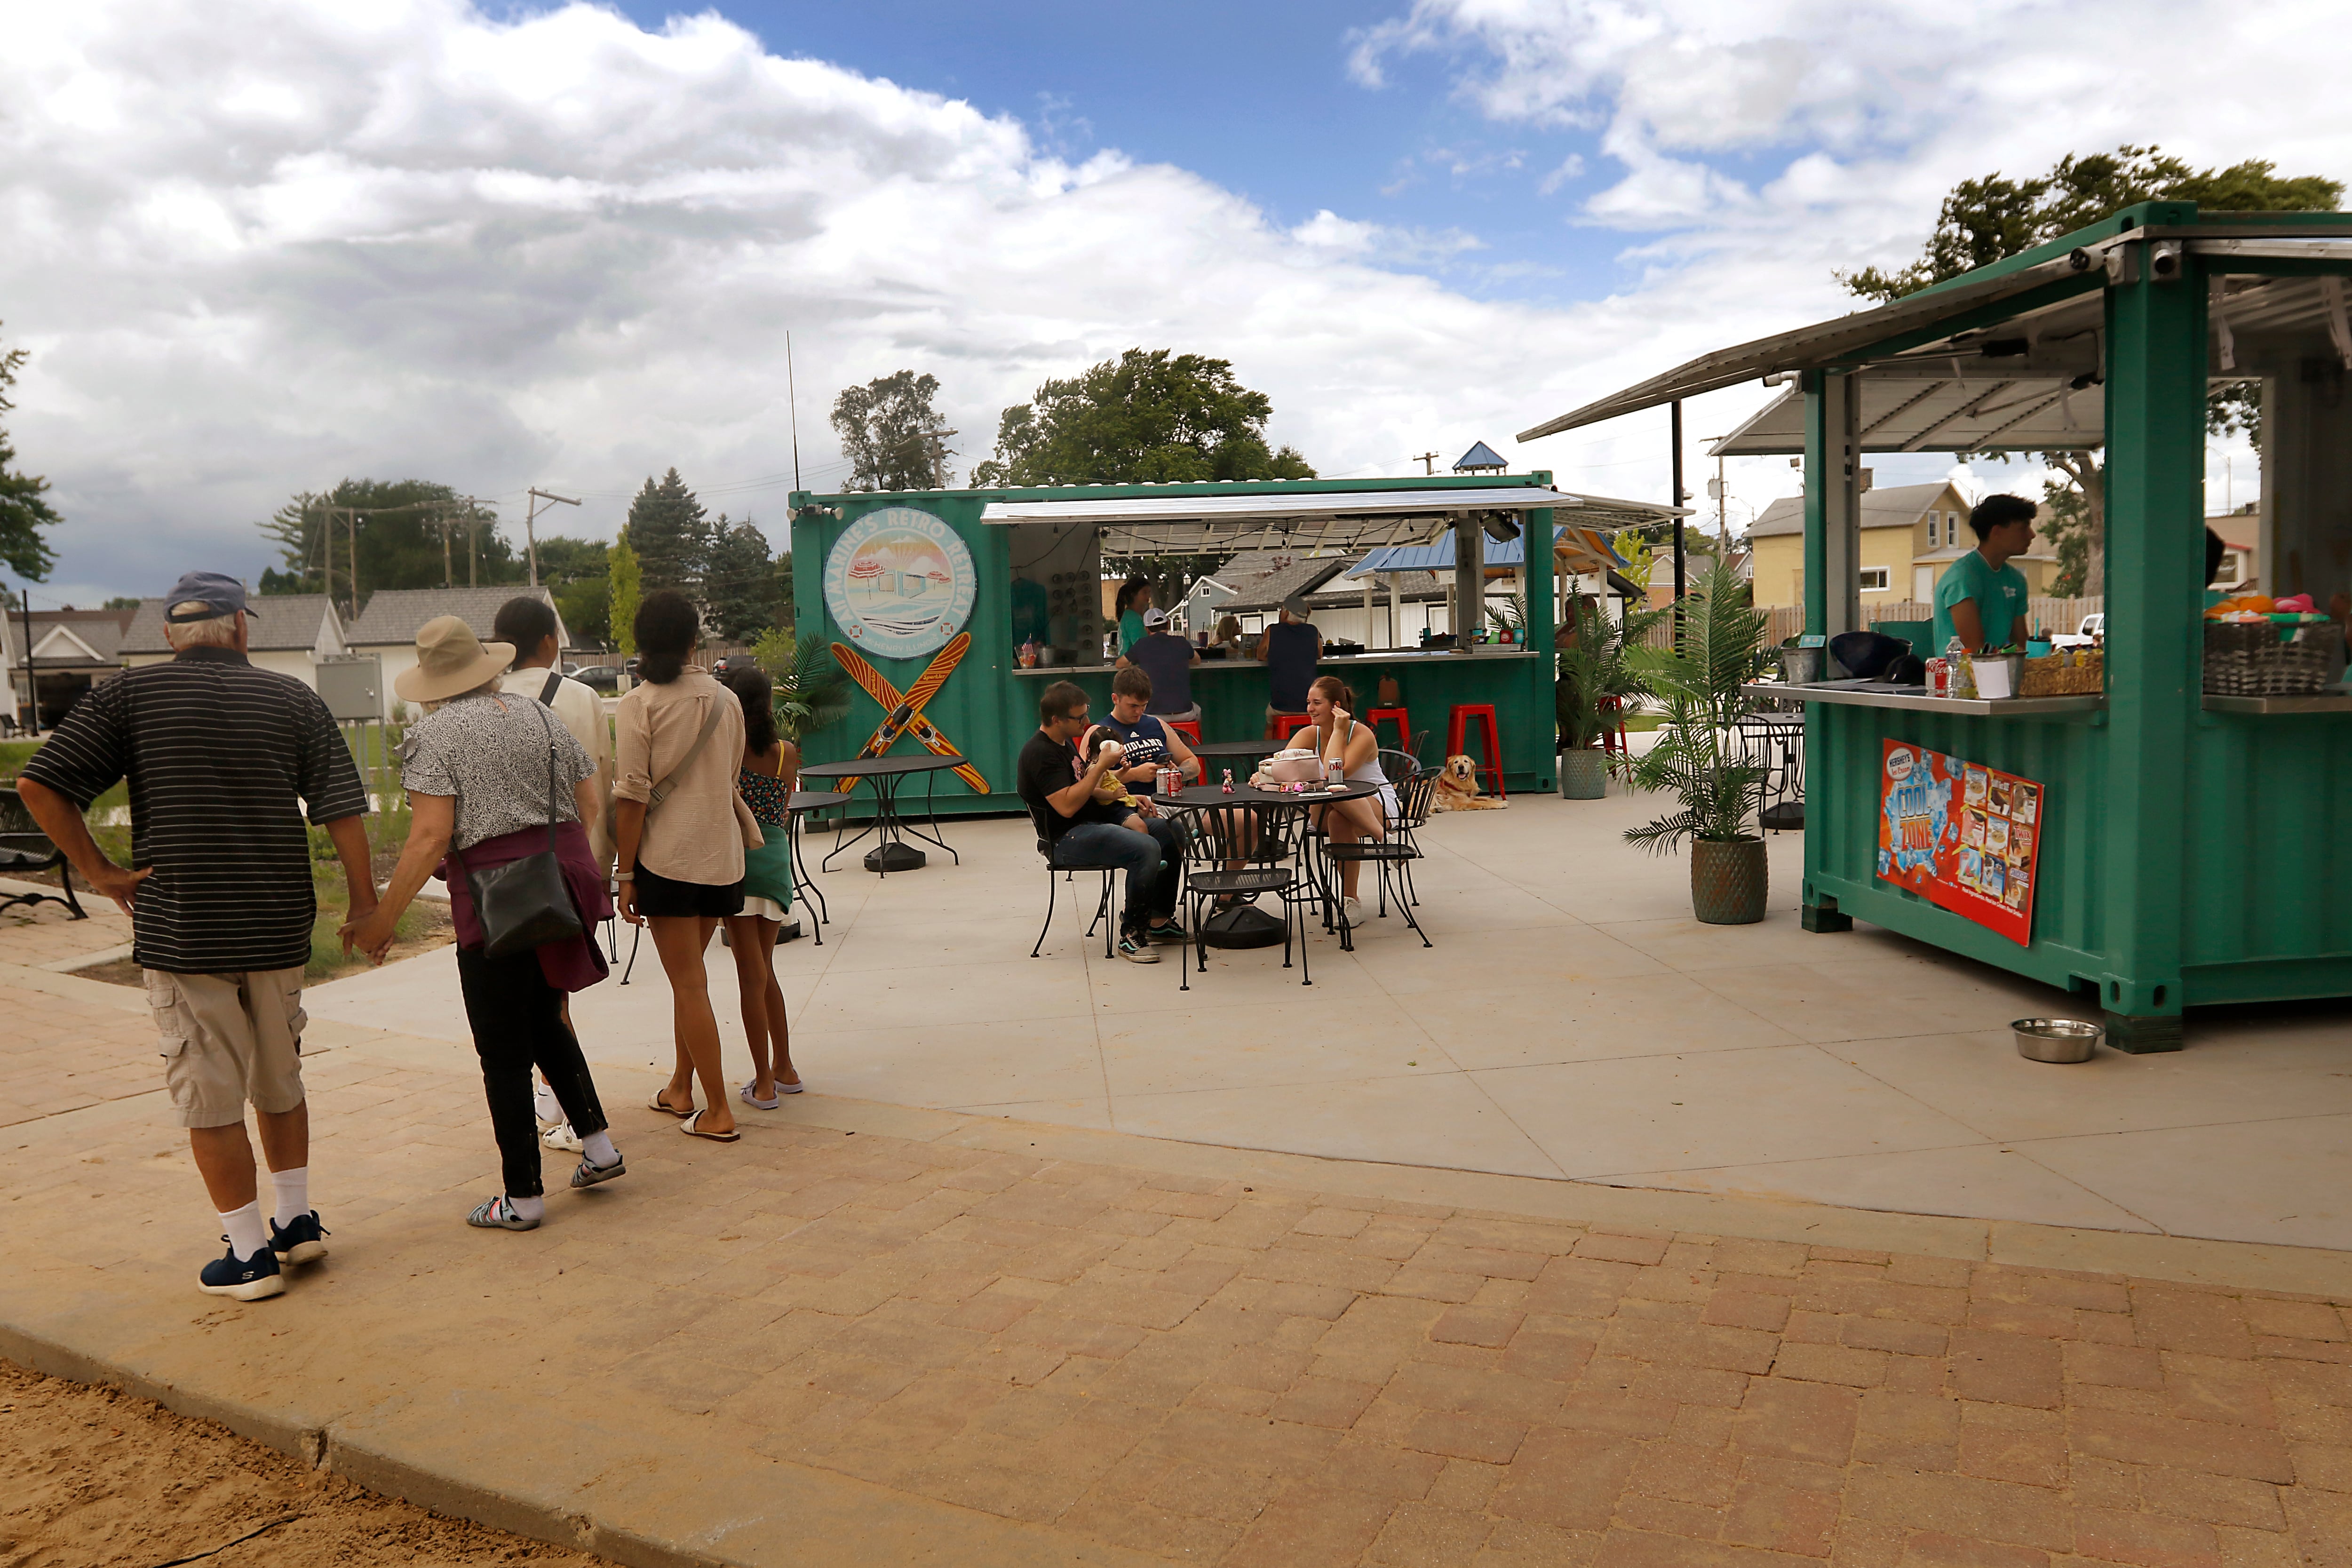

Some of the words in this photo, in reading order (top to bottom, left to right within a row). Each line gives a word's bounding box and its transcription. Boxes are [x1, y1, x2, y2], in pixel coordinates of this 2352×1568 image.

[827, 516, 879, 595] MARINE'S
[887, 509, 946, 538] RETRO
[946, 540, 973, 619] RETREAT
[864, 636, 904, 652] McHENRY
[906, 634, 939, 652] ILLINOIS
[1127, 747, 1160, 758] LACROSSE
[1889, 753, 1910, 768] HERSHEY'S
[1328, 762, 1343, 771] oke
[1898, 784, 1932, 819] COOL
[1899, 818, 1934, 852] ZONE
